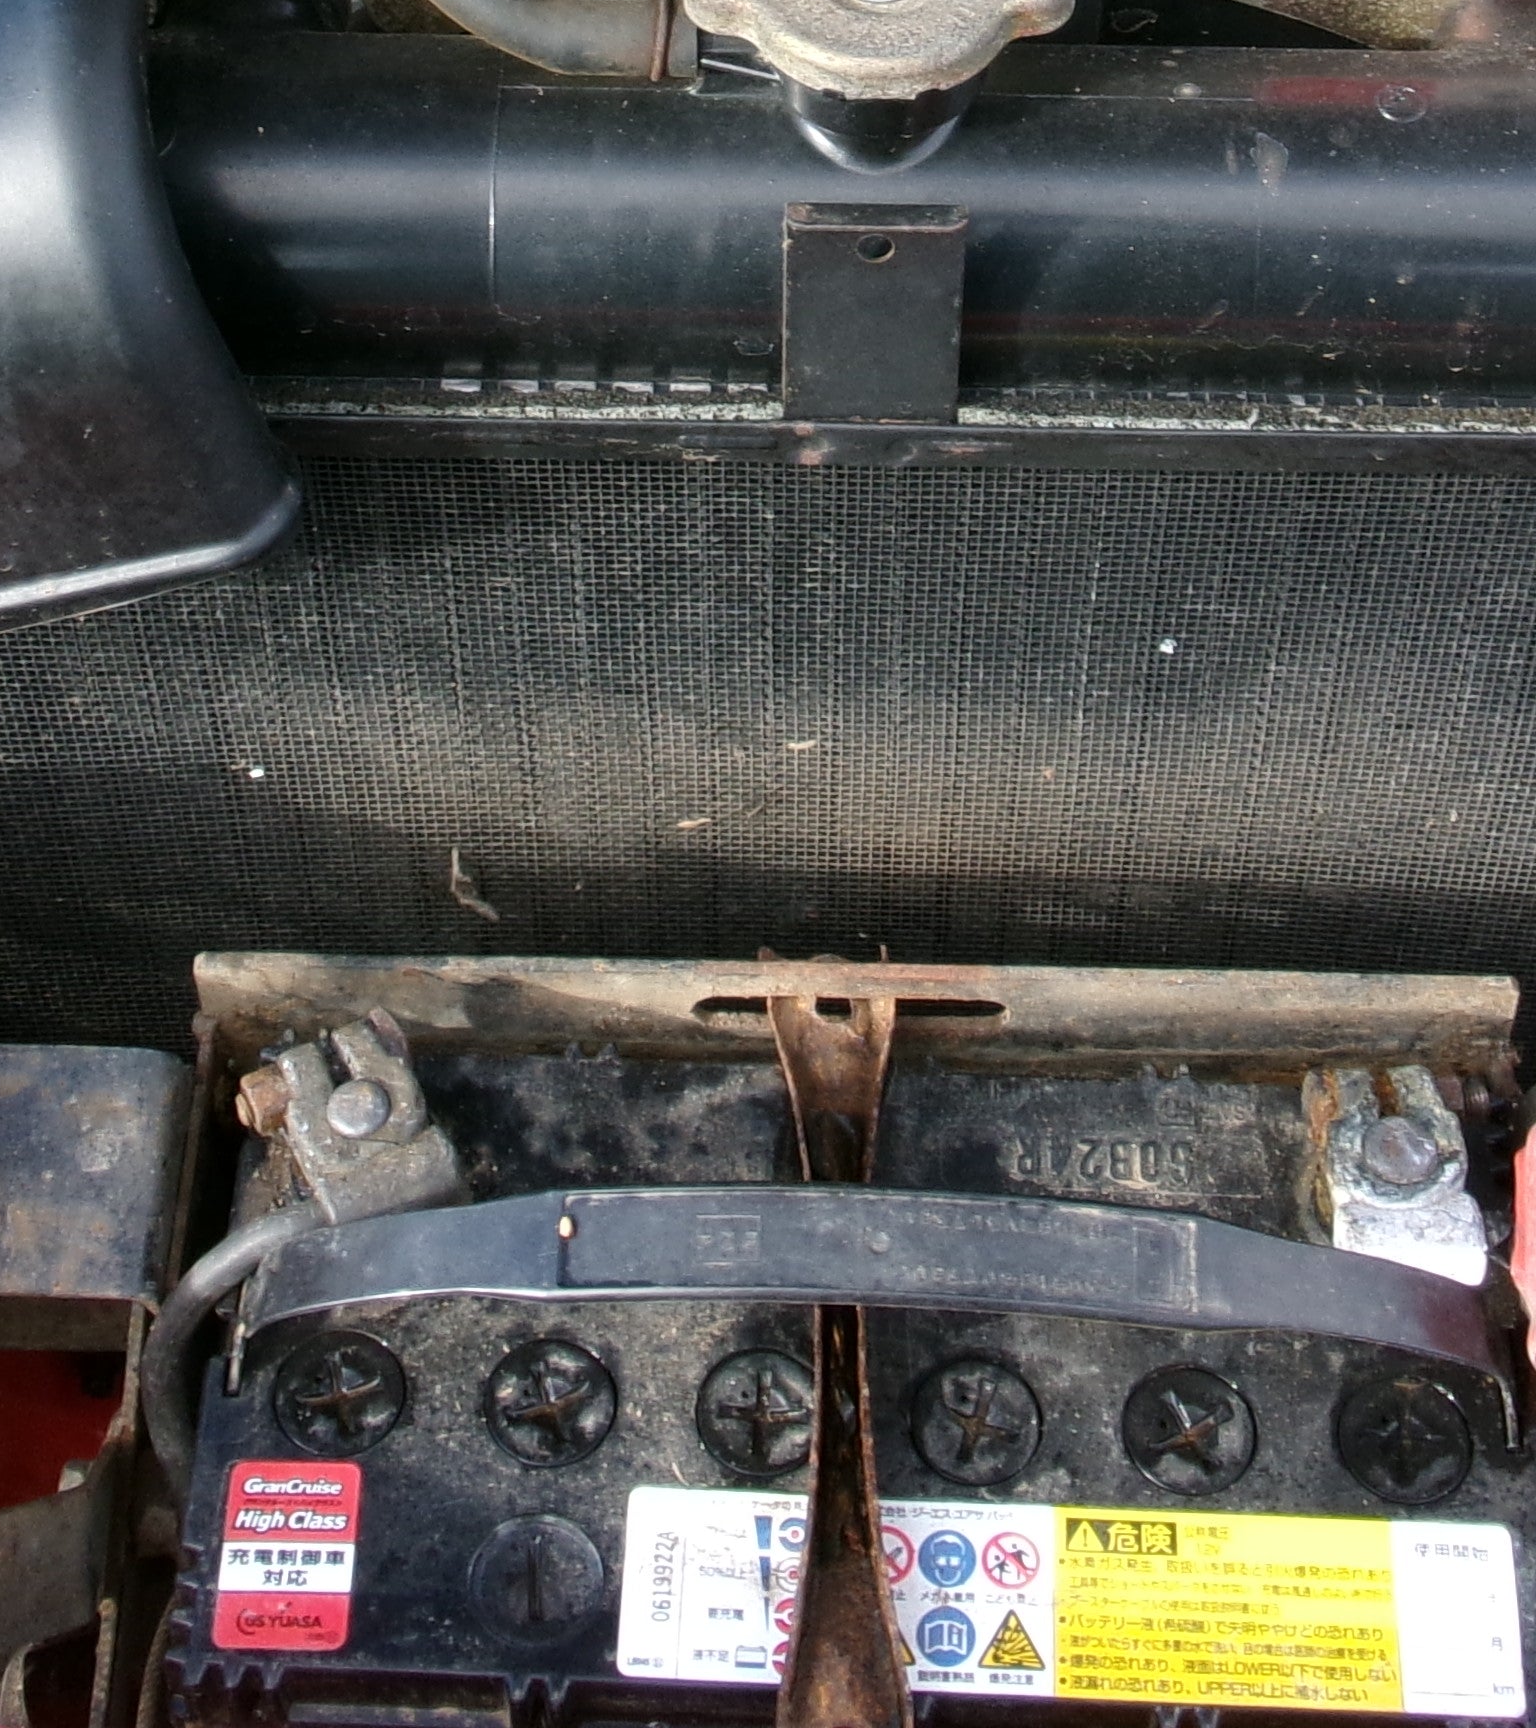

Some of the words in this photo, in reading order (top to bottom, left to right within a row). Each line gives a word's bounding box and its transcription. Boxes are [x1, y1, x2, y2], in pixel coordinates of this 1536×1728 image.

[243, 1477, 343, 1495] GranCruise
[234, 1509, 286, 1533] High
[287, 1511, 348, 1530] Class
[1107, 1522, 1173, 1554] 危険
[227, 1548, 346, 1567] 充電制御車
[261, 1569, 309, 1586] 対応
[1493, 1682, 1515, 1696] km
